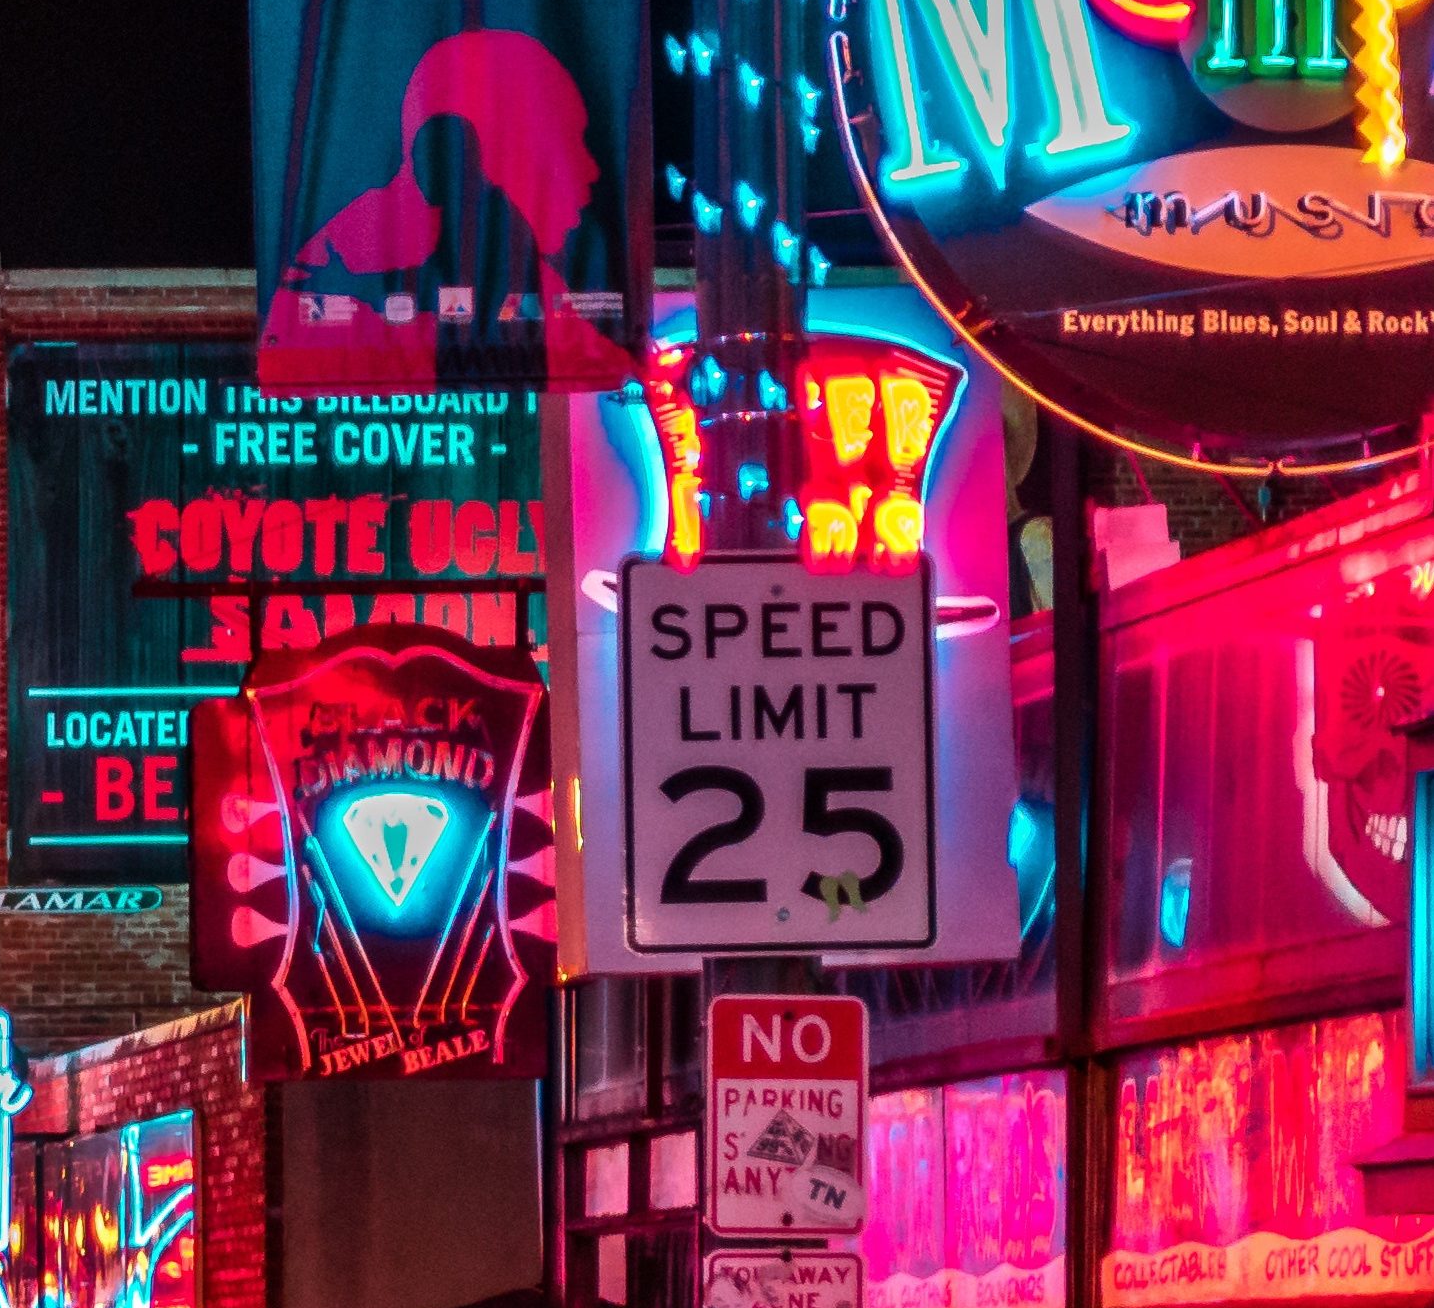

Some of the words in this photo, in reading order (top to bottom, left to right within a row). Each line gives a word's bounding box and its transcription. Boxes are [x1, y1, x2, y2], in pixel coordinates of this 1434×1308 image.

[1062, 309, 1195, 337] Everything
[1202, 309, 1279, 337] Blues,
[1284, 309, 1339, 334] Soul
[1343, 309, 1363, 334] &
[44, 378, 207, 415] MENTION
[214, 423, 318, 465] FREE
[333, 421, 476, 466] COVER
[127, 497, 388, 576] COYOTE
[650, 603, 906, 661] SPEED
[309, 696, 483, 734] BLACK
[680, 683, 878, 742] LIMIT
[96, 756, 188, 822] BE
[296, 740, 496, 794] DIAMOND
[658, 764, 905, 905] 25
[319, 1030, 400, 1076] JEWEL
[403, 1029, 491, 1075] BEALE
[742, 1013, 832, 1064] NO
[723, 1088, 844, 1120] PARKING
[808, 1177, 848, 1210] TN
[1113, 1251, 1227, 1291] COLLECTABLES
[1264, 1244, 1321, 1282] OTHER
[1327, 1243, 1372, 1279] COOL
